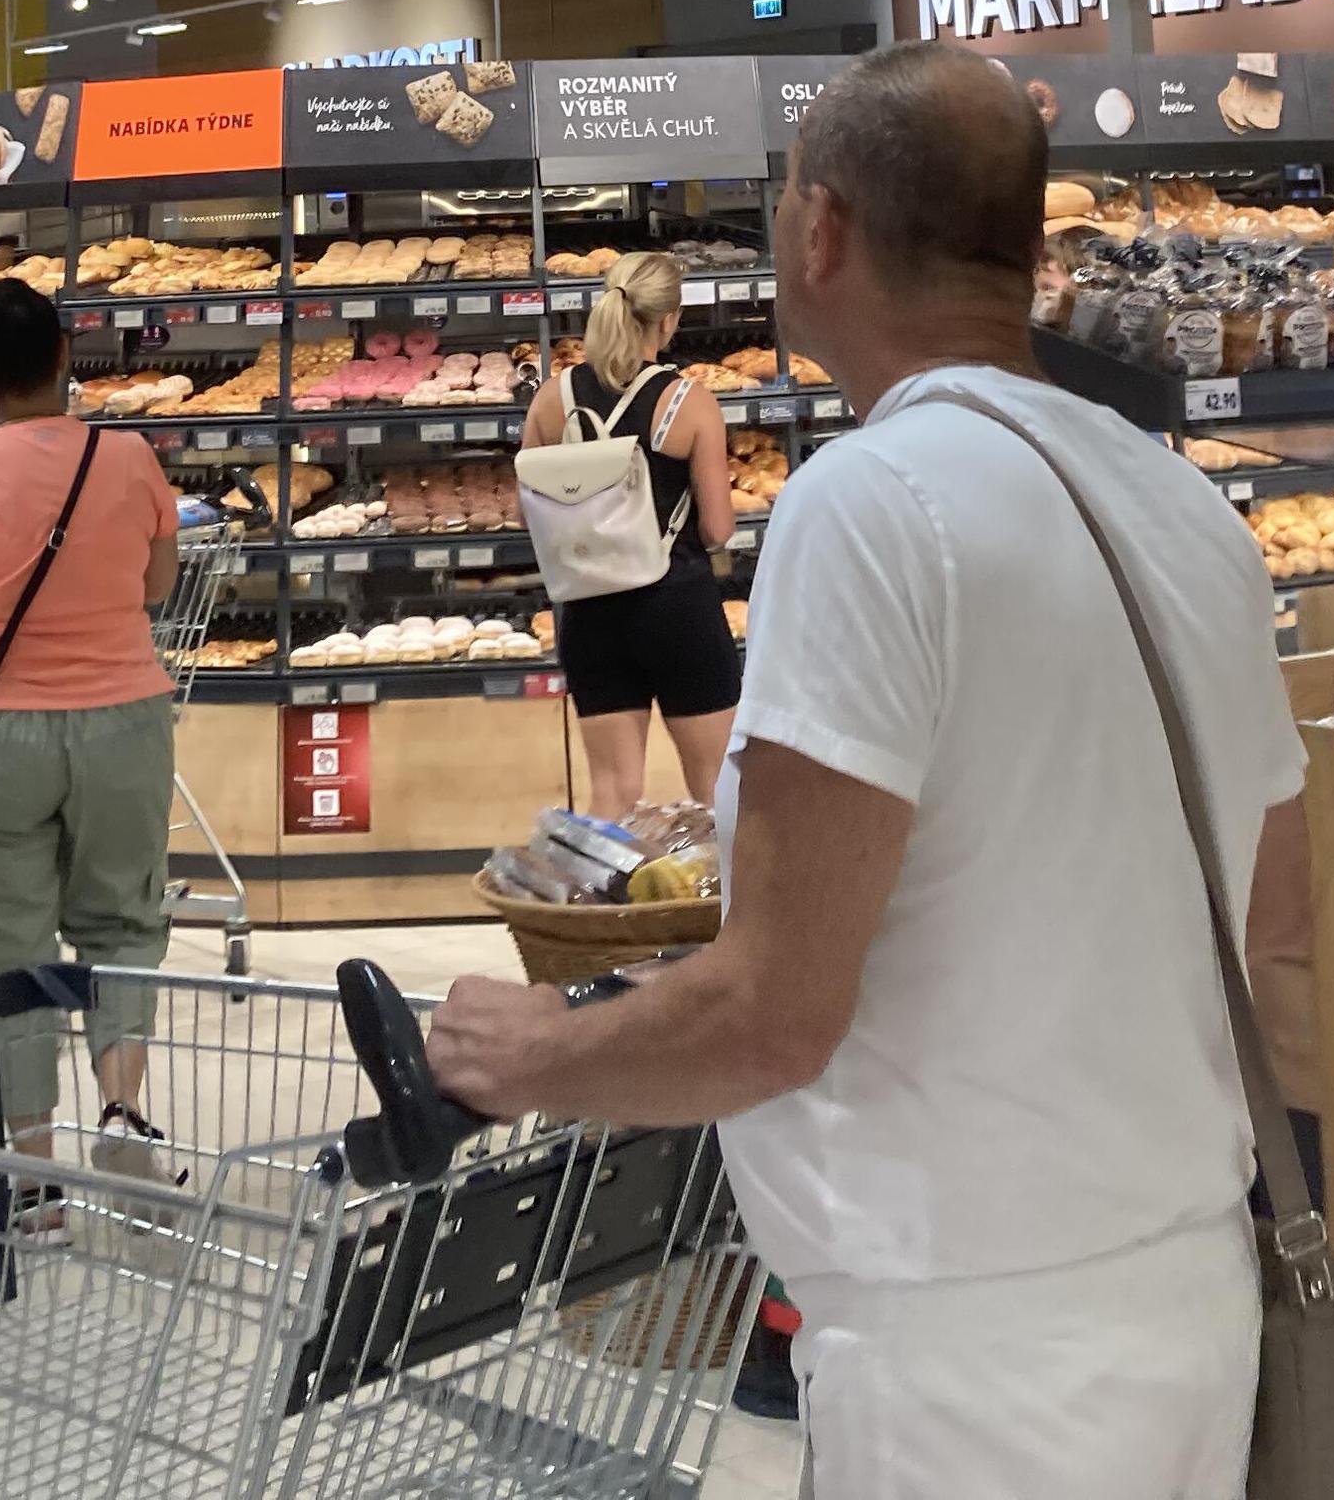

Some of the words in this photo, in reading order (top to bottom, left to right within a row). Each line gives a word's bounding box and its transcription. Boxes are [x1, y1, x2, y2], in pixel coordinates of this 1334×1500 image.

[282, 37, 479, 70] KOSTI
[558, 71, 678, 95] ROZMANITÝ
[307, 97, 373, 118] Vychutnejte
[377, 97, 391, 111] si
[560, 97, 628, 117] VÝBĚR
[783, 105, 799, 123] SI
[109, 116, 189, 138] NABÍDKA
[196, 112, 254, 132] TÝDNE
[563, 123, 578, 140] A
[582, 117, 658, 139] SKVĚLÁ
[662, 117, 719, 138] CHUŤ.
[1205, 392, 1237, 411] 42.90
